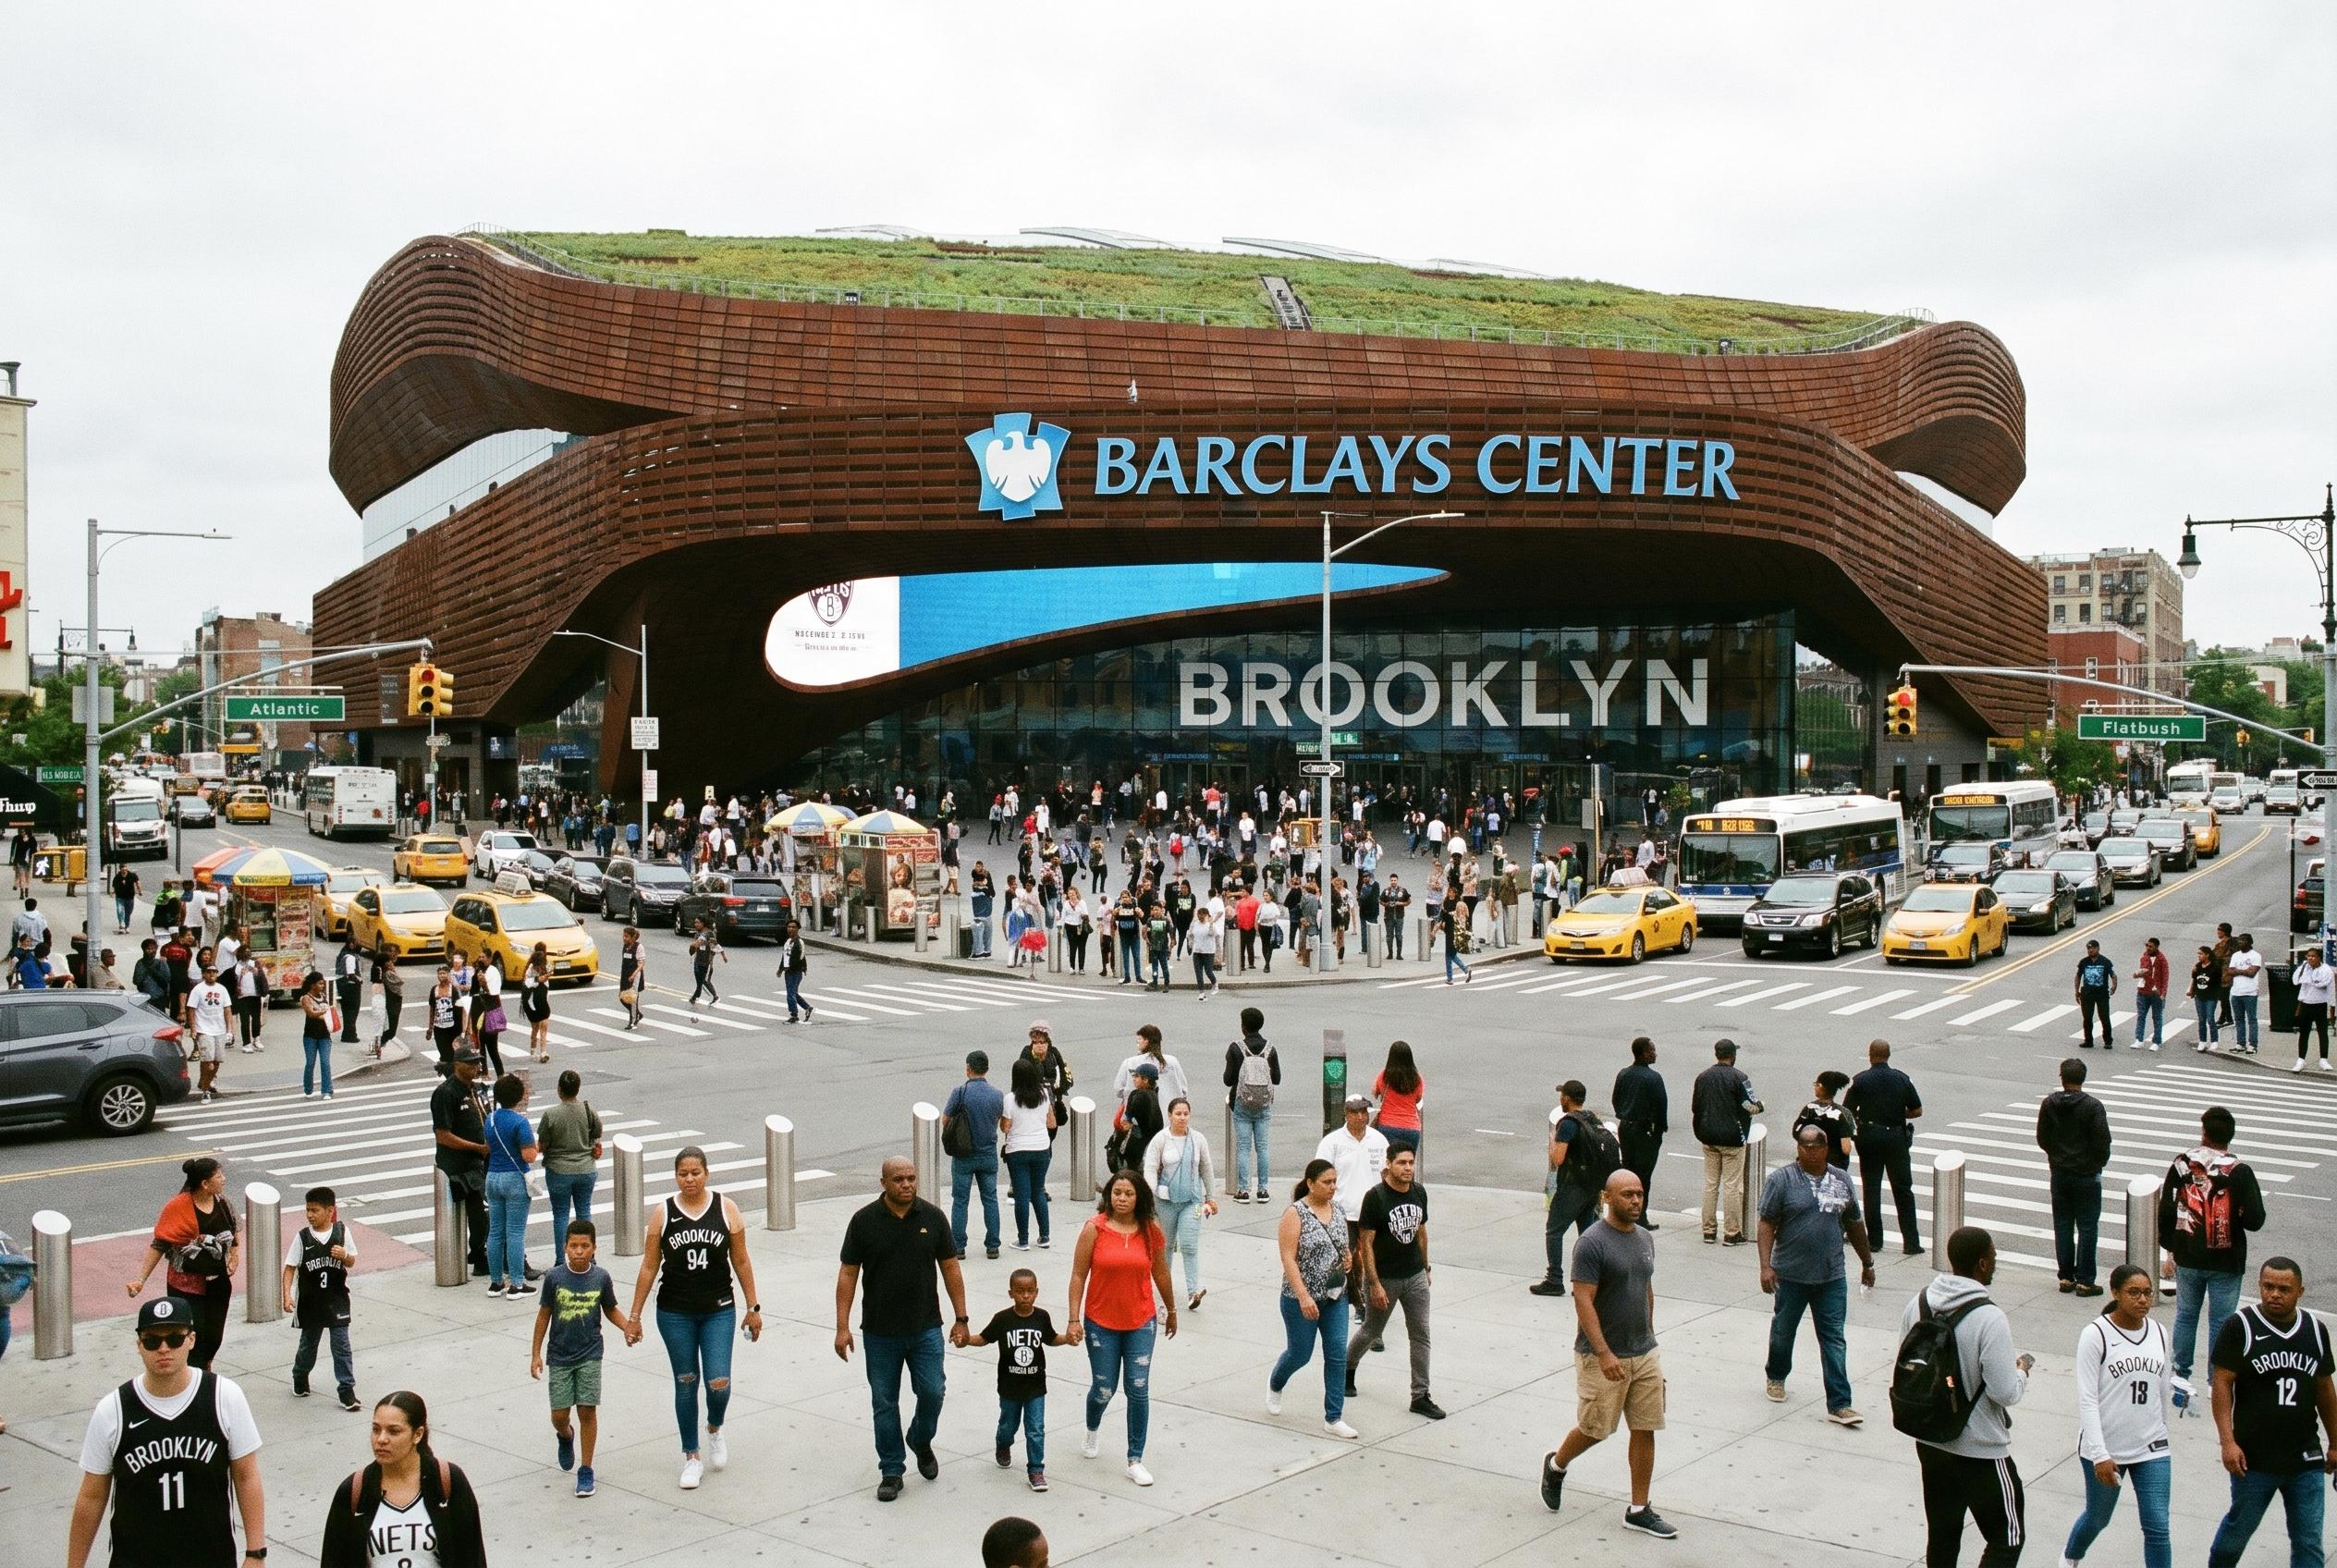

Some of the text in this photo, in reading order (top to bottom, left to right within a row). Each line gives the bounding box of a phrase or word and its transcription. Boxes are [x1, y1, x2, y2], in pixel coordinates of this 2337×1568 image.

[1094, 434, 1741, 500] BARCLAYS CENTER
[1180, 657, 1708, 729] BROOKLYN
[250, 703, 320, 716] Atlantic
[2103, 721, 2181, 735] Flatbush
[668, 1229, 725, 1250] BROOKLYN
[687, 1248, 708, 1270] 94
[1007, 1329, 1042, 1348] NETS
[2109, 1356, 2164, 1378] BROOKLYN
[2251, 1351, 2319, 1377] BROOKLYN
[2276, 1378, 2297, 1405] 12
[124, 1436, 218, 1474] BROOKLYN
[159, 1472, 185, 1511] 11
[369, 1523, 437, 1558] NETS
